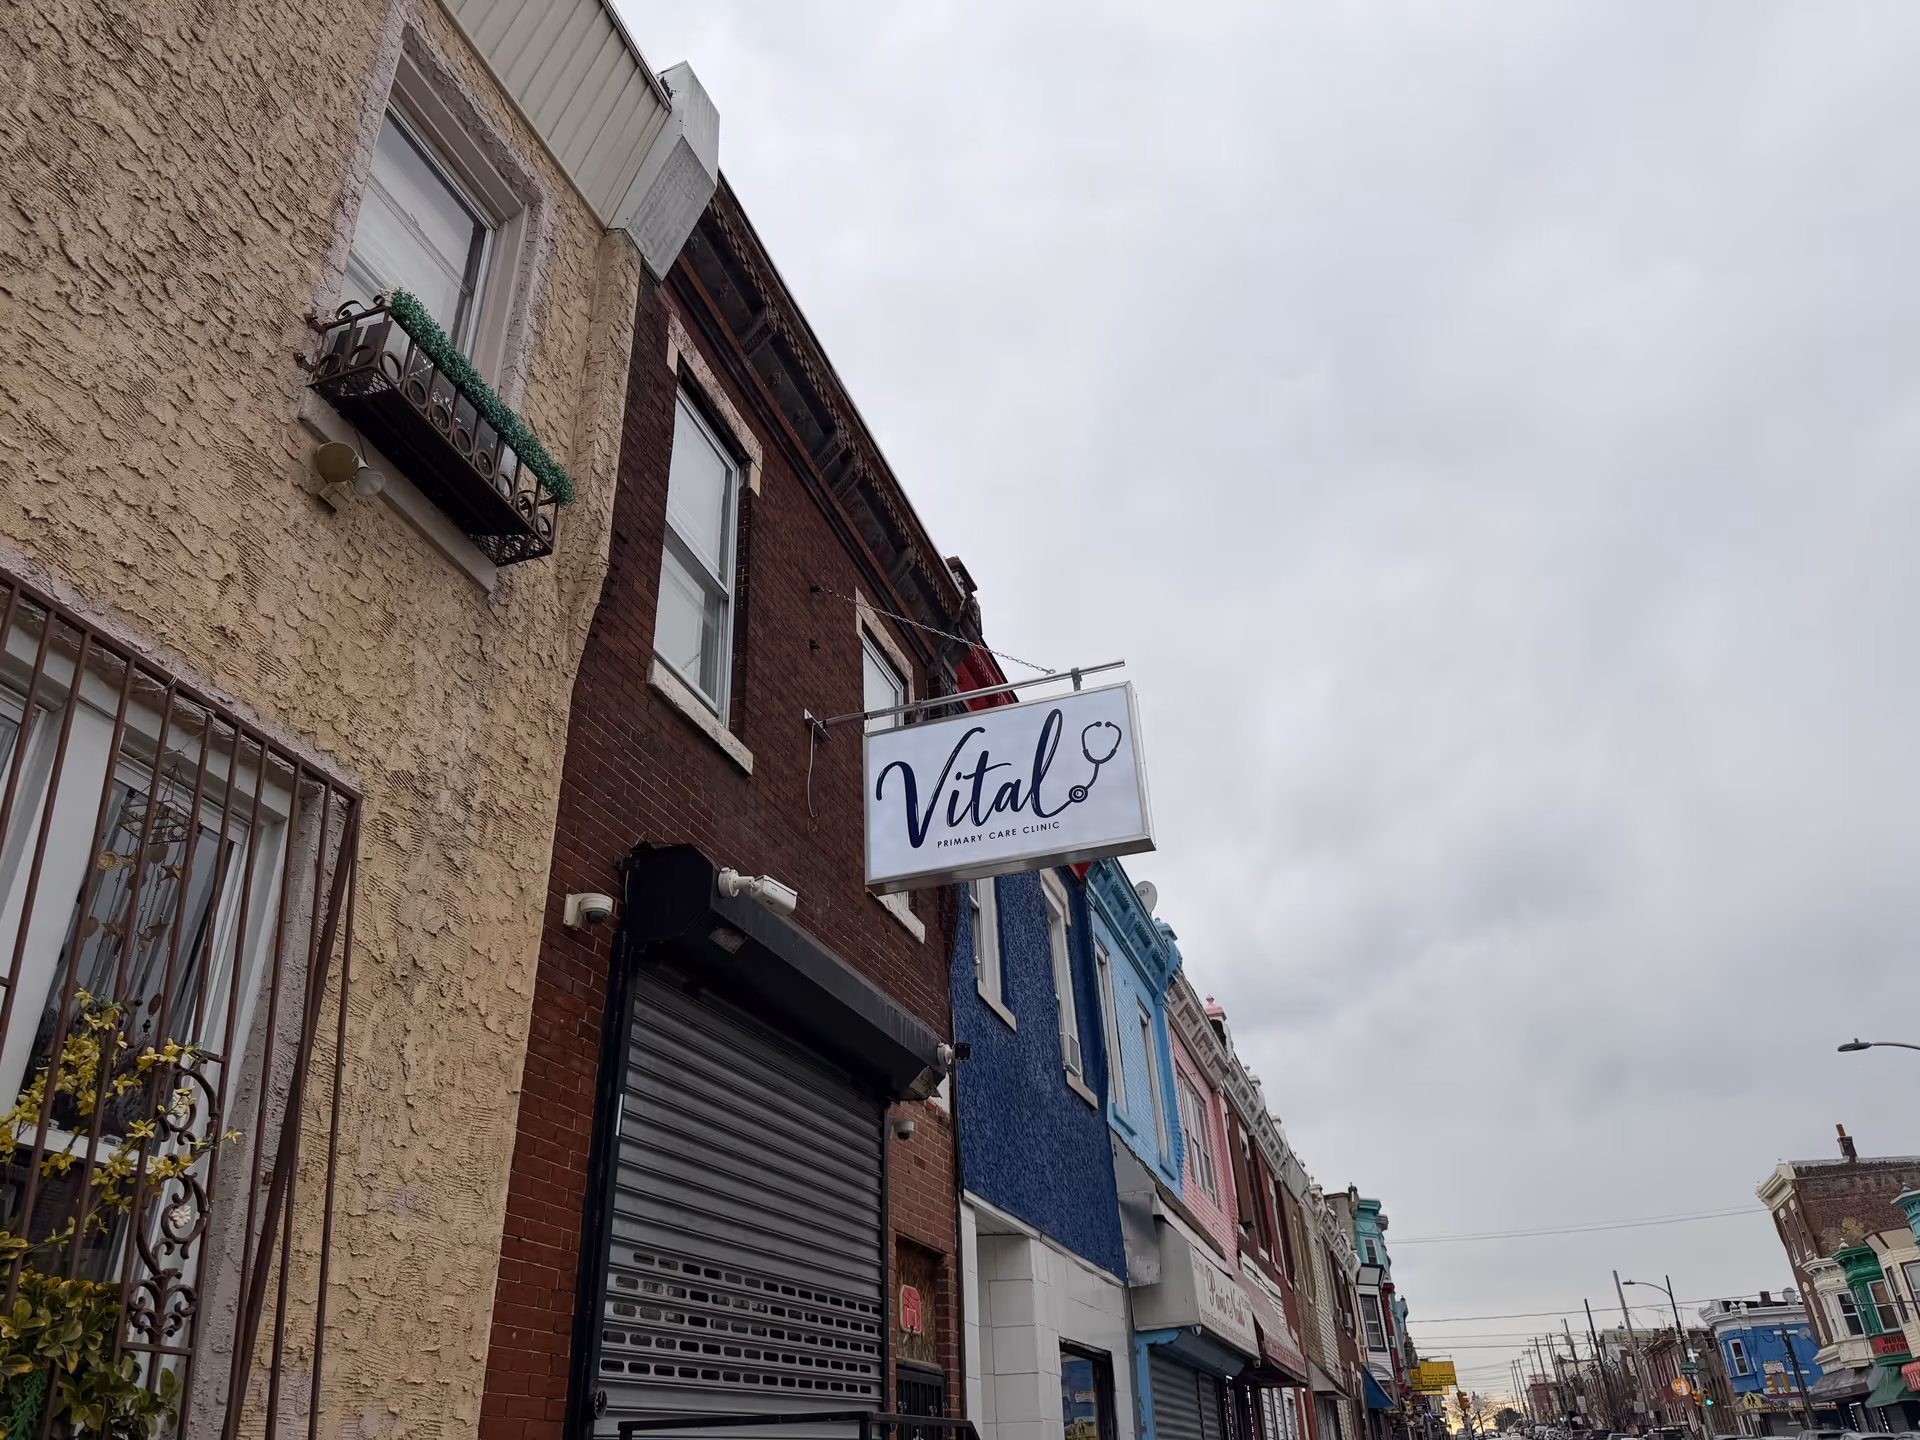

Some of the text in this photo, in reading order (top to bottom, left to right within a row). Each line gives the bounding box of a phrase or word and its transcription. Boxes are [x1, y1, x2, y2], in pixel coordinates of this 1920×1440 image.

[876, 708, 1069, 849] Vital
[937, 821, 1060, 848] PRIMARY CARE CLINIC
